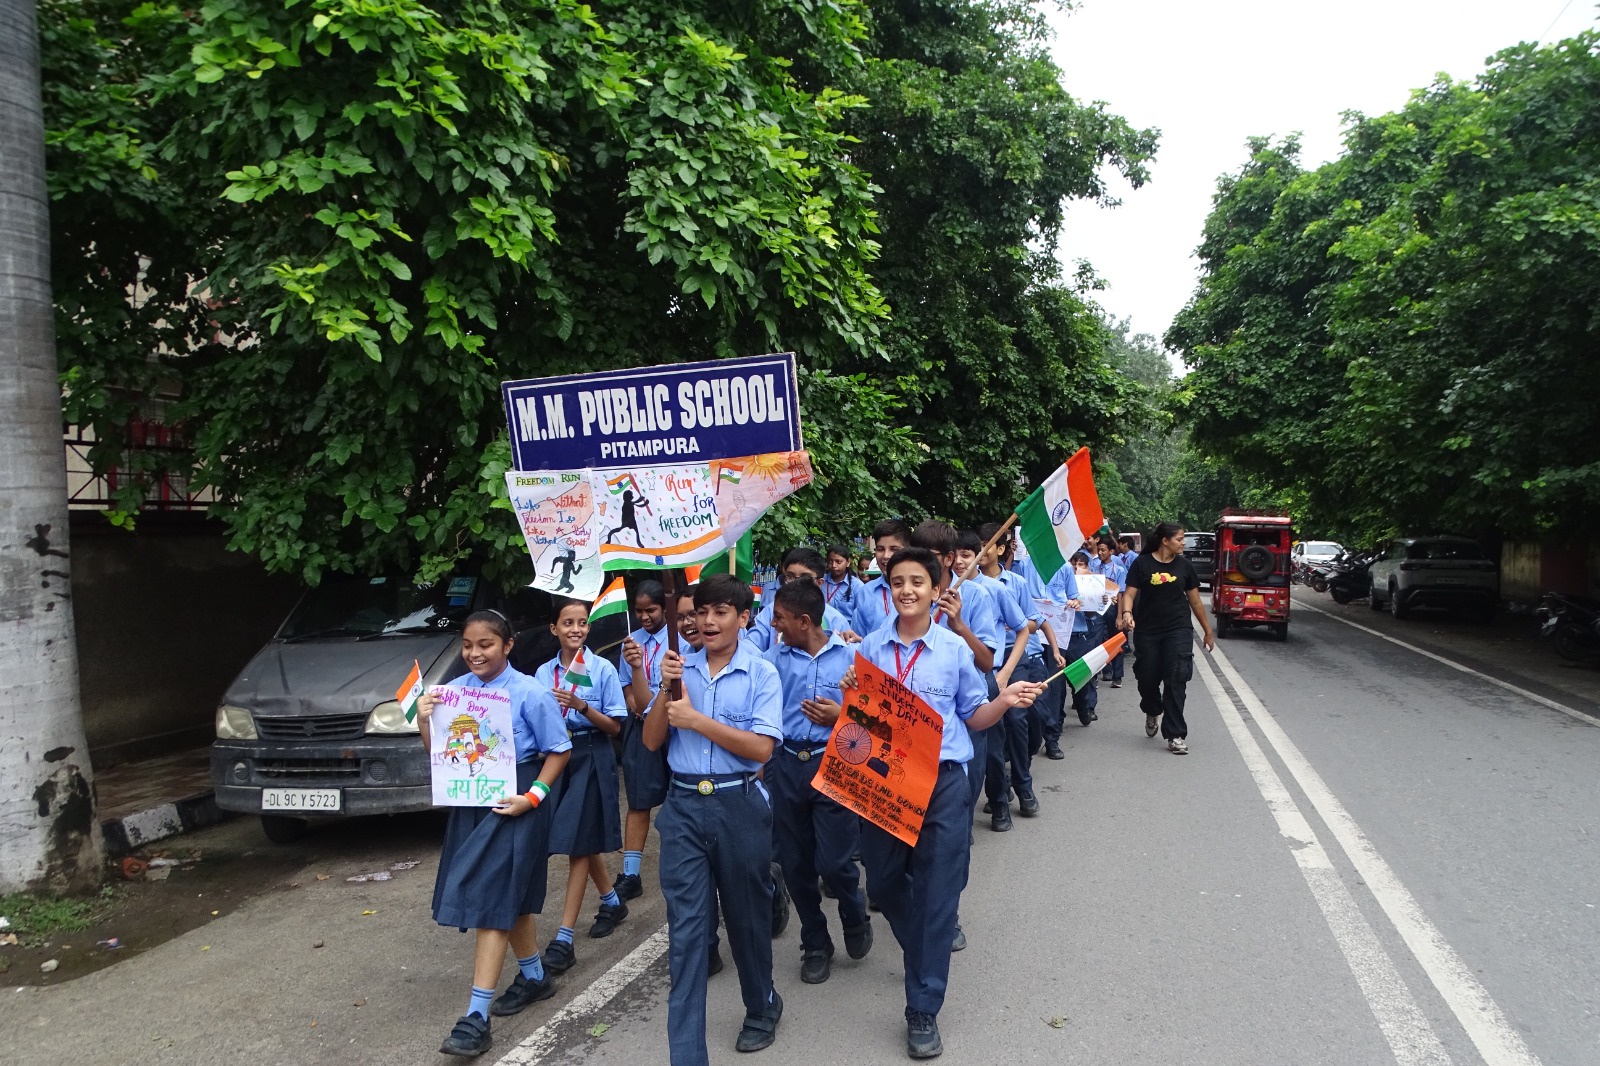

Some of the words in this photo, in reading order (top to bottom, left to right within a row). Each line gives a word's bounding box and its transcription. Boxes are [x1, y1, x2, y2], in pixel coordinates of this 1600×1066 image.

[516, 393, 575, 441] M.M.
[578, 384, 672, 436] PUBLIC
[678, 373, 785, 430] SCHOOL
[601, 437, 700, 459] PITAMPURA
[515, 476, 555, 487] FREEDOM
[561, 473, 581, 483] RUN
[665, 474, 697, 502] Run
[884, 674, 916, 703] HAPPY
[466, 700, 489, 719] Day
[896, 704, 917, 727] DAY
[432, 752, 446, 766] 15
[446, 778, 473, 801] जय
